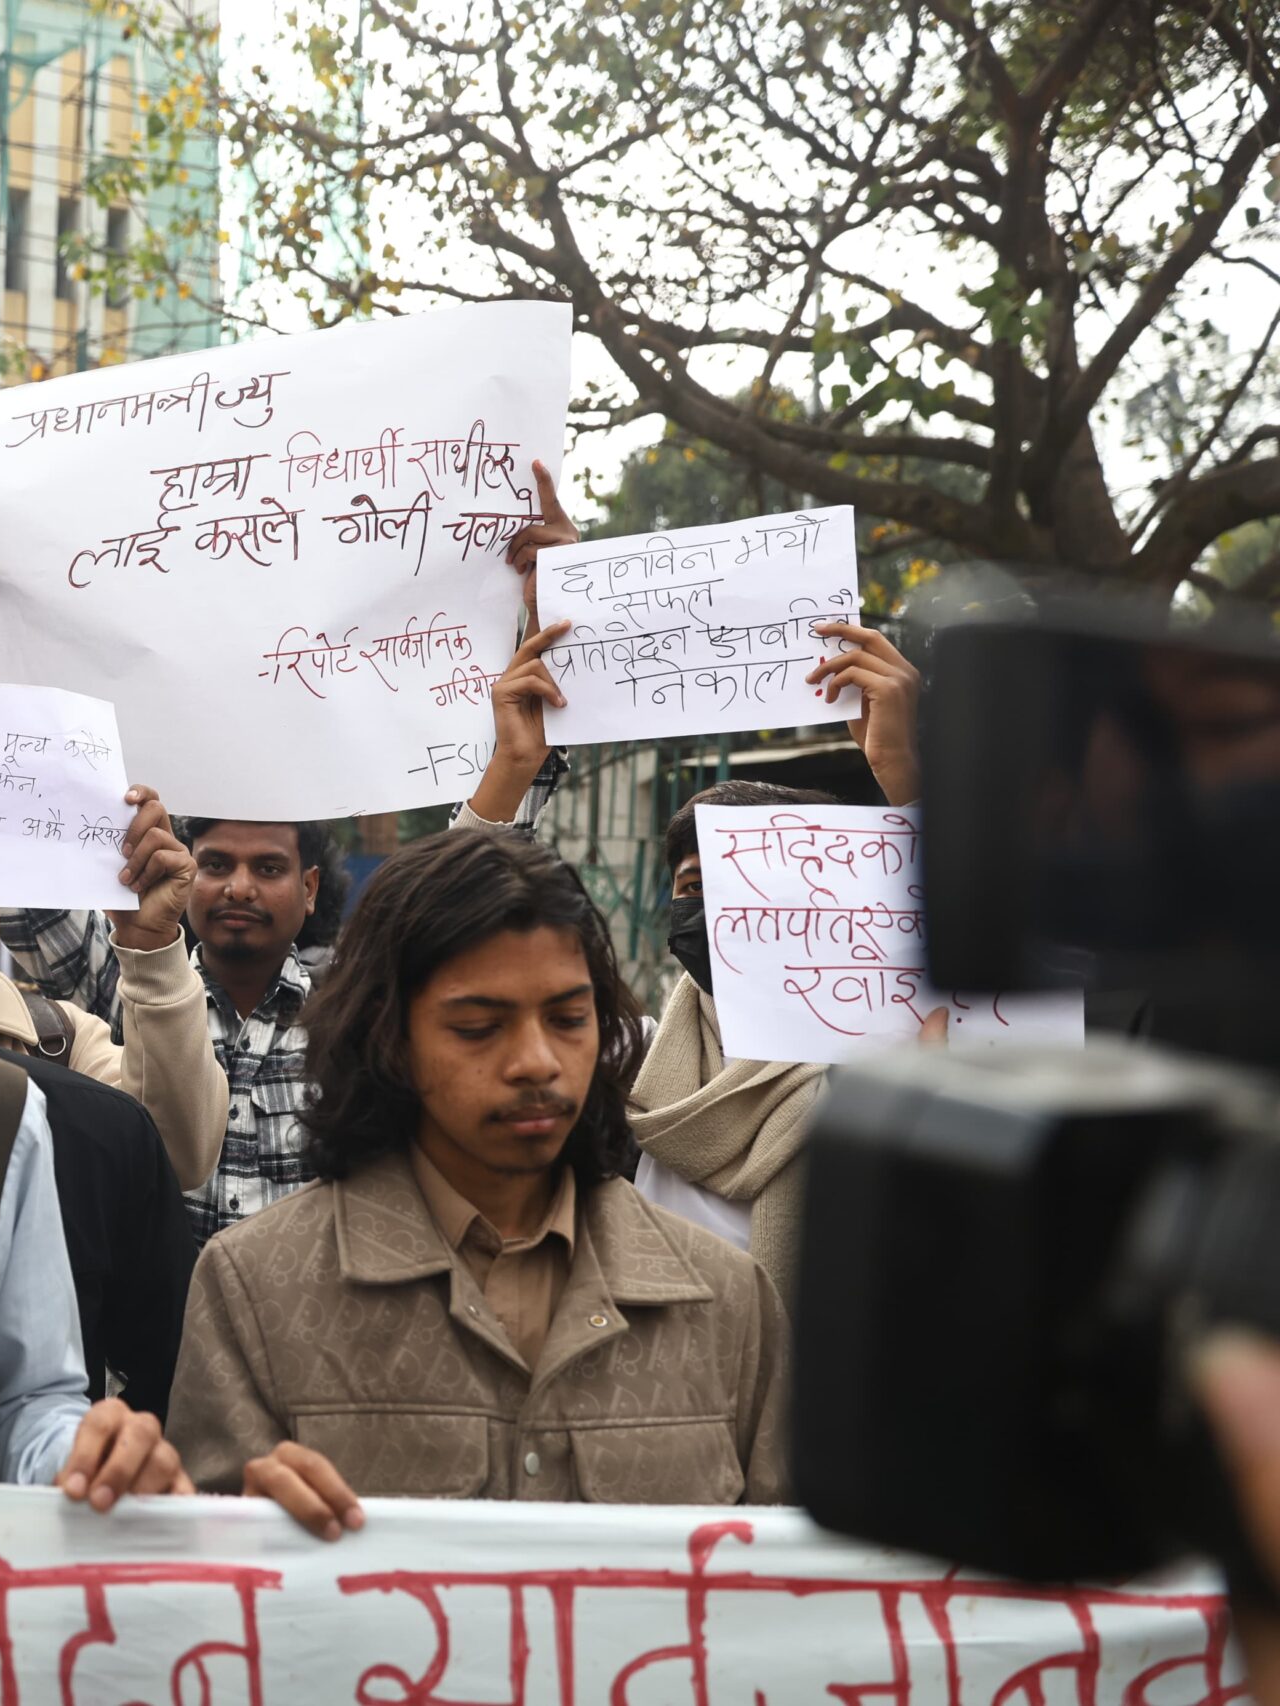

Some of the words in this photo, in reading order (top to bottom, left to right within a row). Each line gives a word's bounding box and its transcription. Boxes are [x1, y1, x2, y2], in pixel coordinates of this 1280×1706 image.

[68, 509, 181, 588] लाई
[195, 496, 305, 567] कसले
[322, 492, 433, 577] गोली
